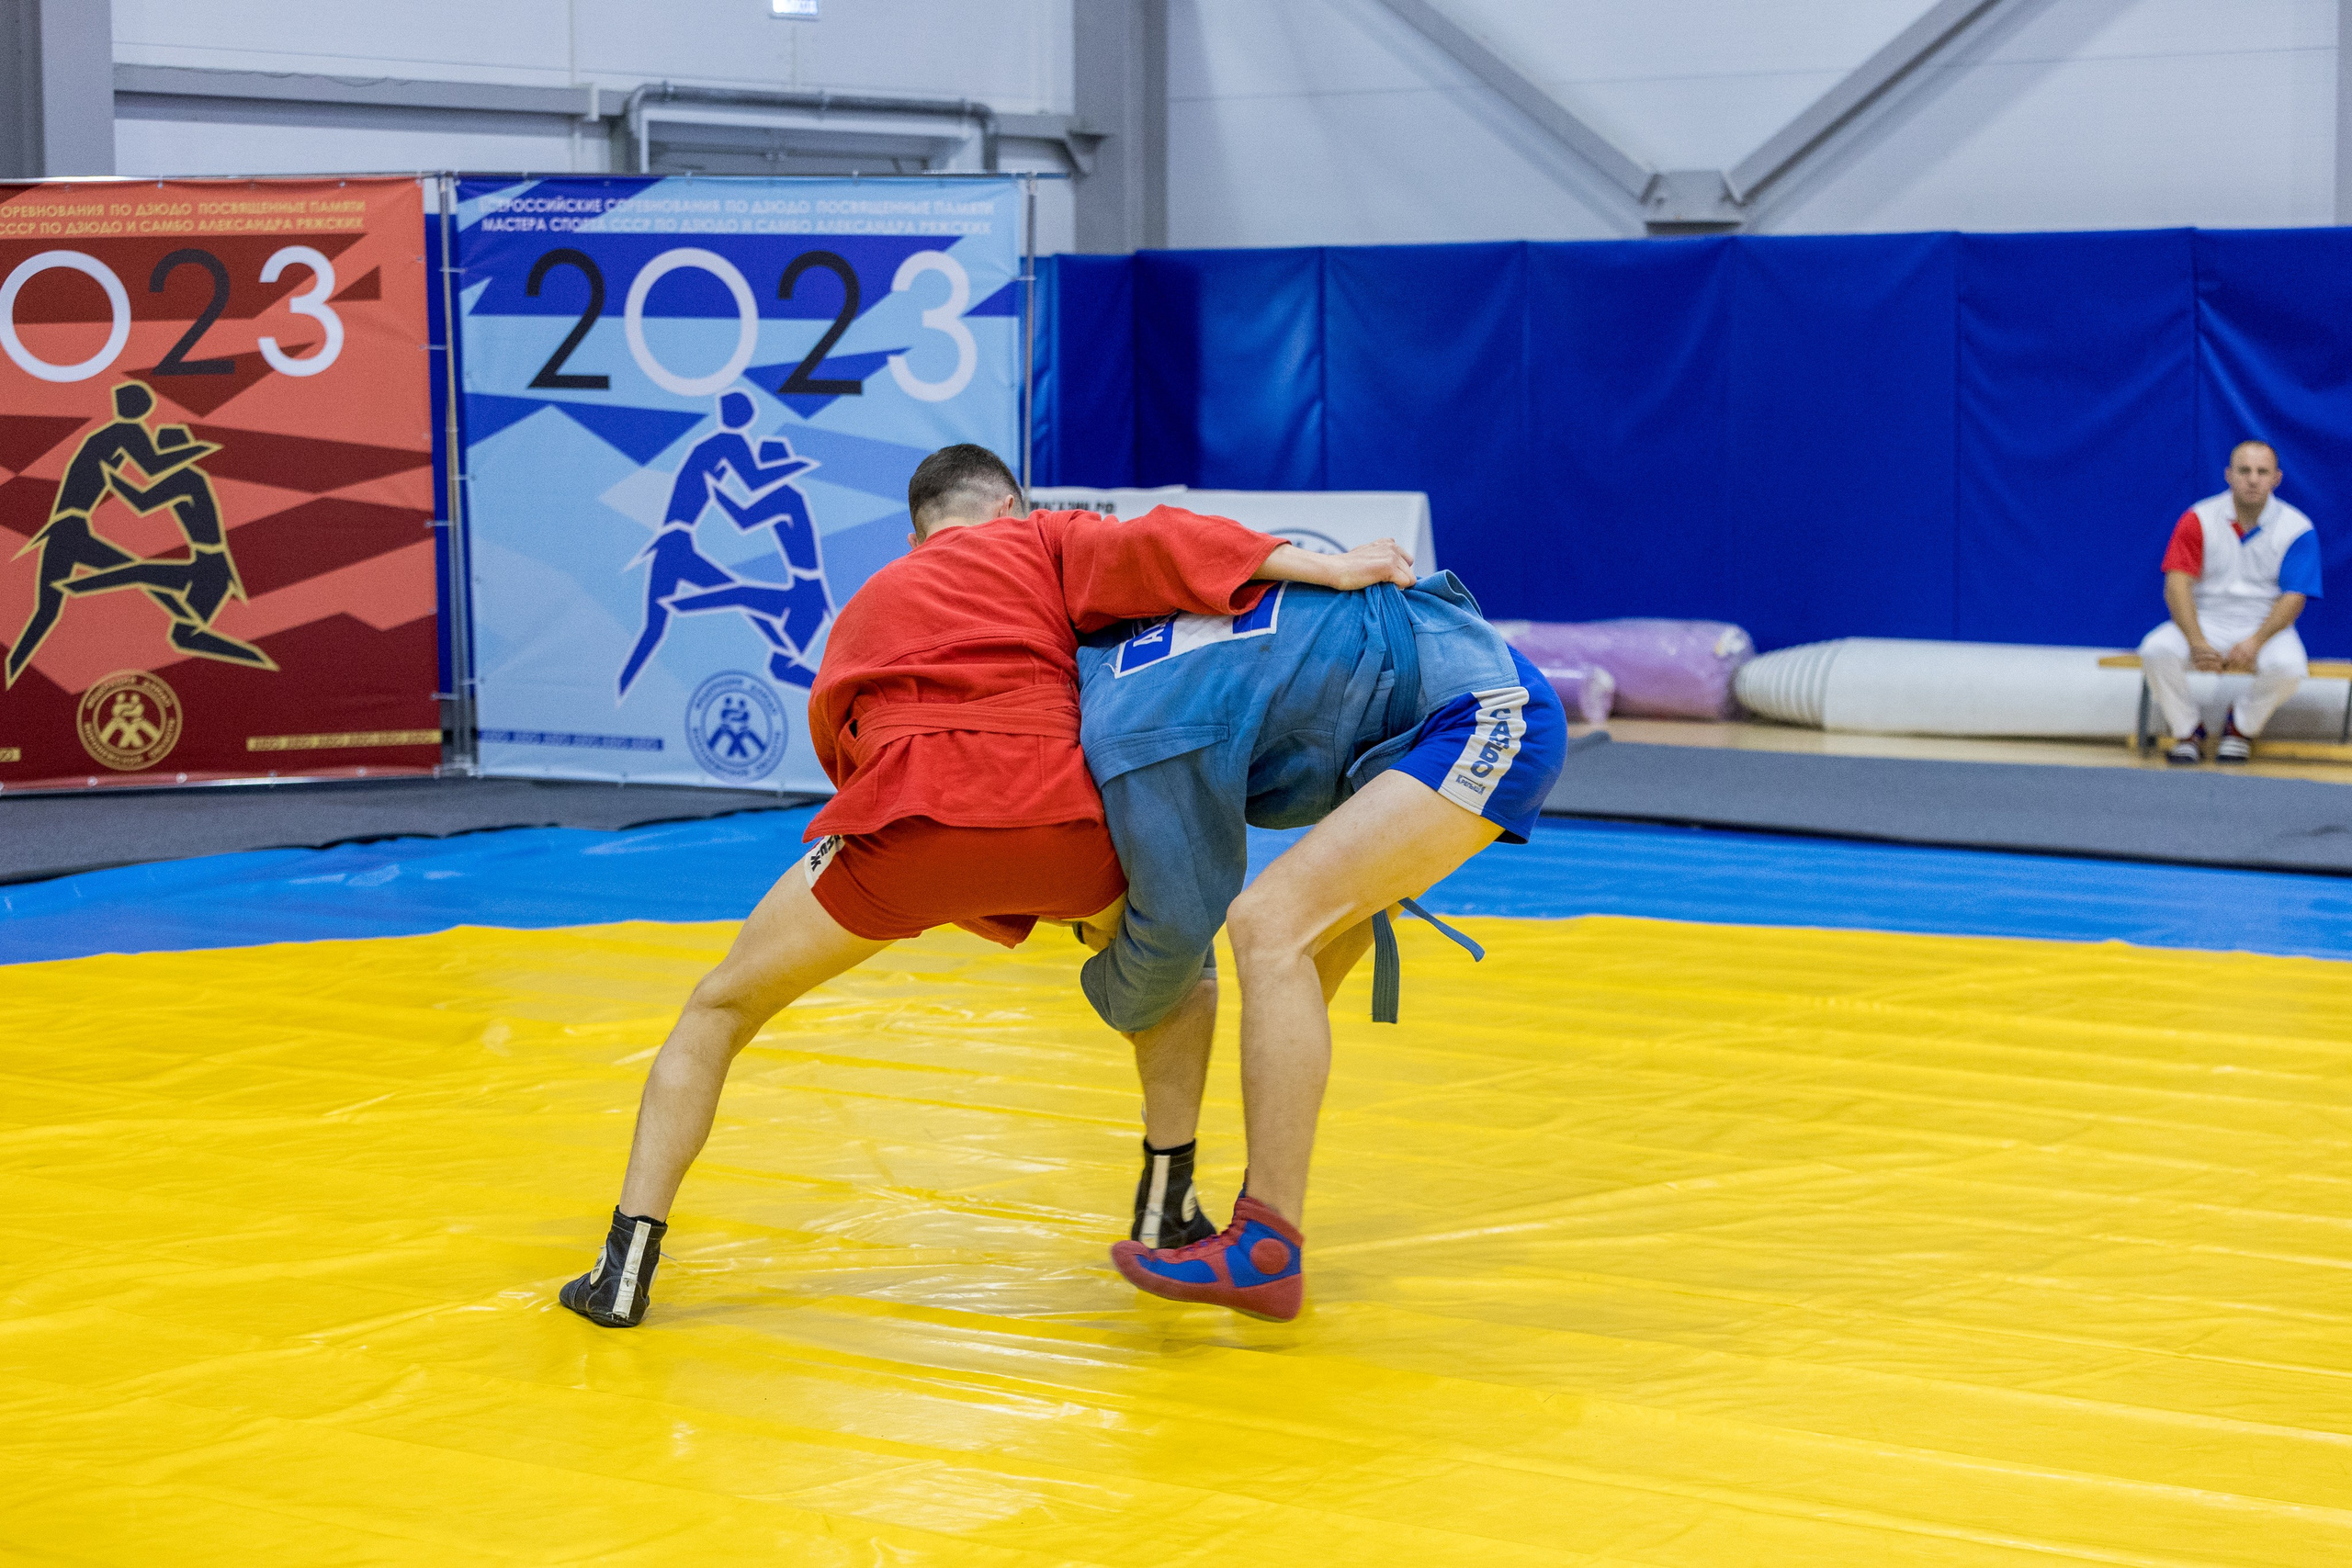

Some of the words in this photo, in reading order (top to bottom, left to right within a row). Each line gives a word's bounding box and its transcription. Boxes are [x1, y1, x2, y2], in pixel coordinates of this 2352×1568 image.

[0, 204, 105, 218] ОРЕВНОВАНИЯ
[109, 203, 132, 216] ПО
[136, 202, 193, 216] ДЗЮДО
[40, 221, 62, 234] ПО
[65, 220, 123, 234] ДЗЮДО
[127, 220, 136, 231] И
[140, 219, 195, 232] САМБО
[481, 217, 548, 231] МАСТЕРА
[0, 245, 345, 383] 023
[525, 246, 978, 402] 2023
